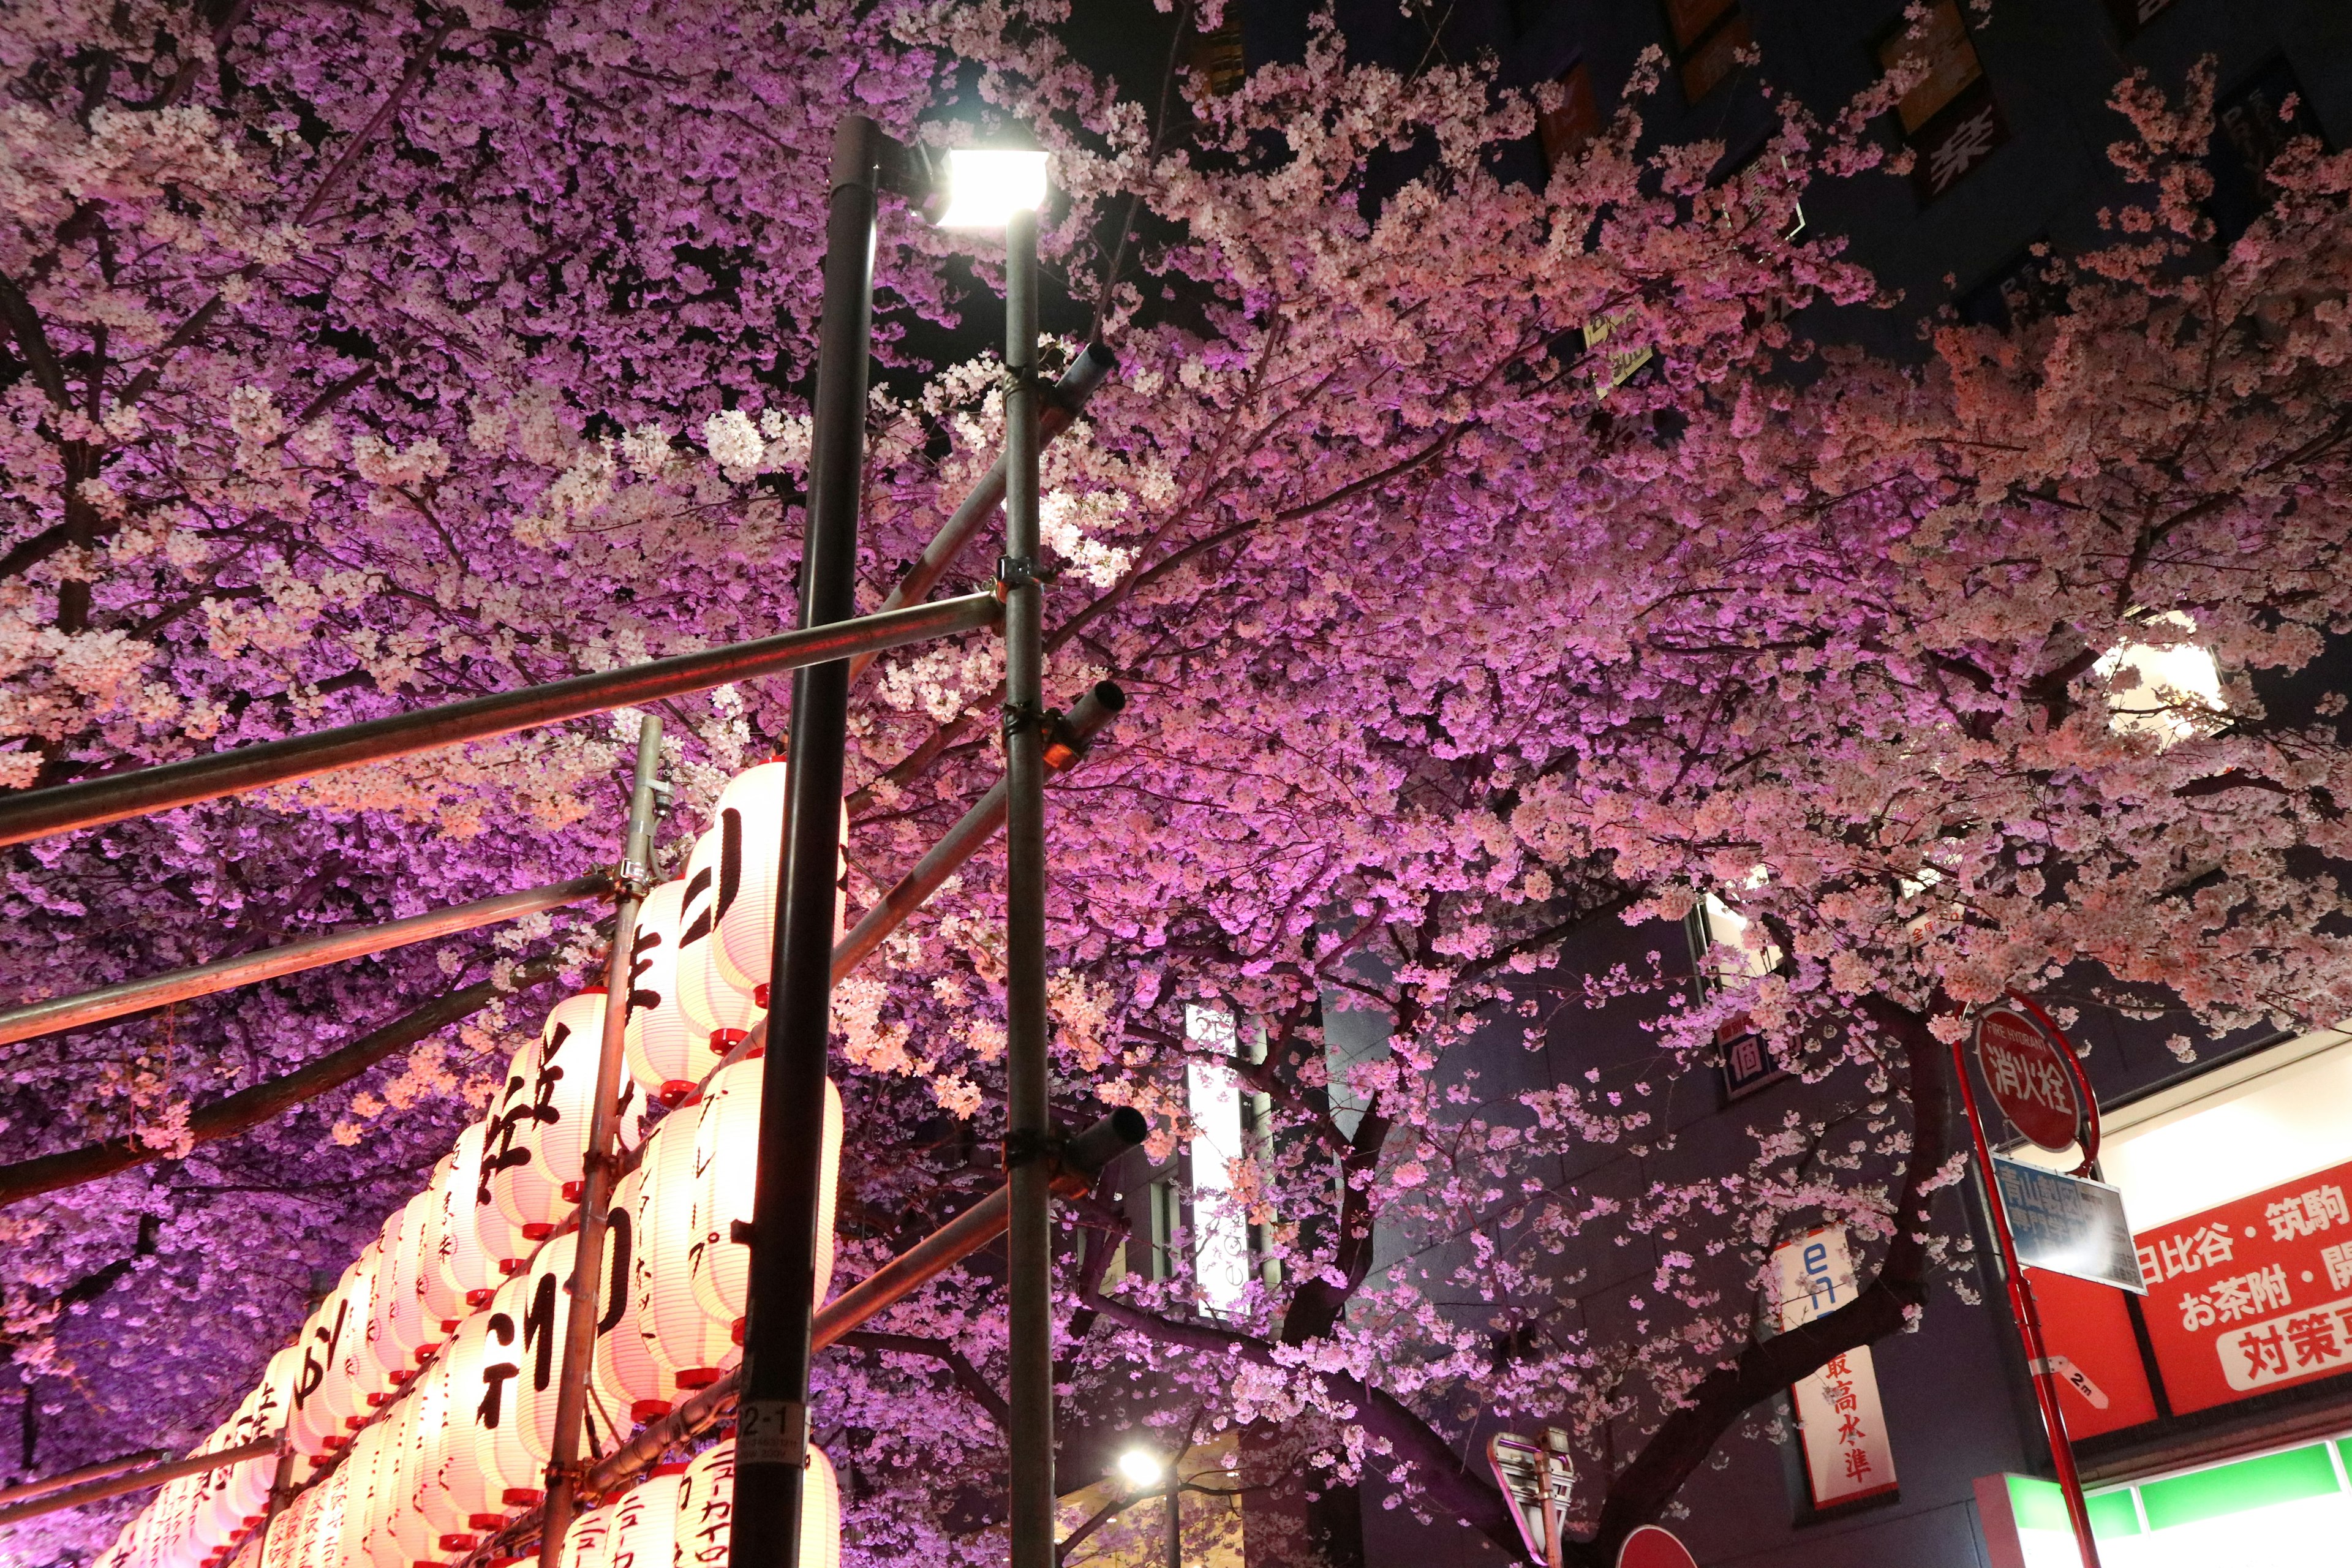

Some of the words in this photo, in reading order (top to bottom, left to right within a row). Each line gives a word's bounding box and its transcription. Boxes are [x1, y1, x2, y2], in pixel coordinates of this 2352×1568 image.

[1986, 1020, 2007, 1039] FIRE
[2007, 1027, 2047, 1052] HYDRANT
[1985, 1042, 2073, 1115] 消火栓
[2136, 1184, 2351, 1286] 日比谷・筑駒
[1803, 1242, 1836, 1319] en
[1825, 1351, 1872, 1483] 最高水準
[2070, 1372, 2092, 1396] 2m
